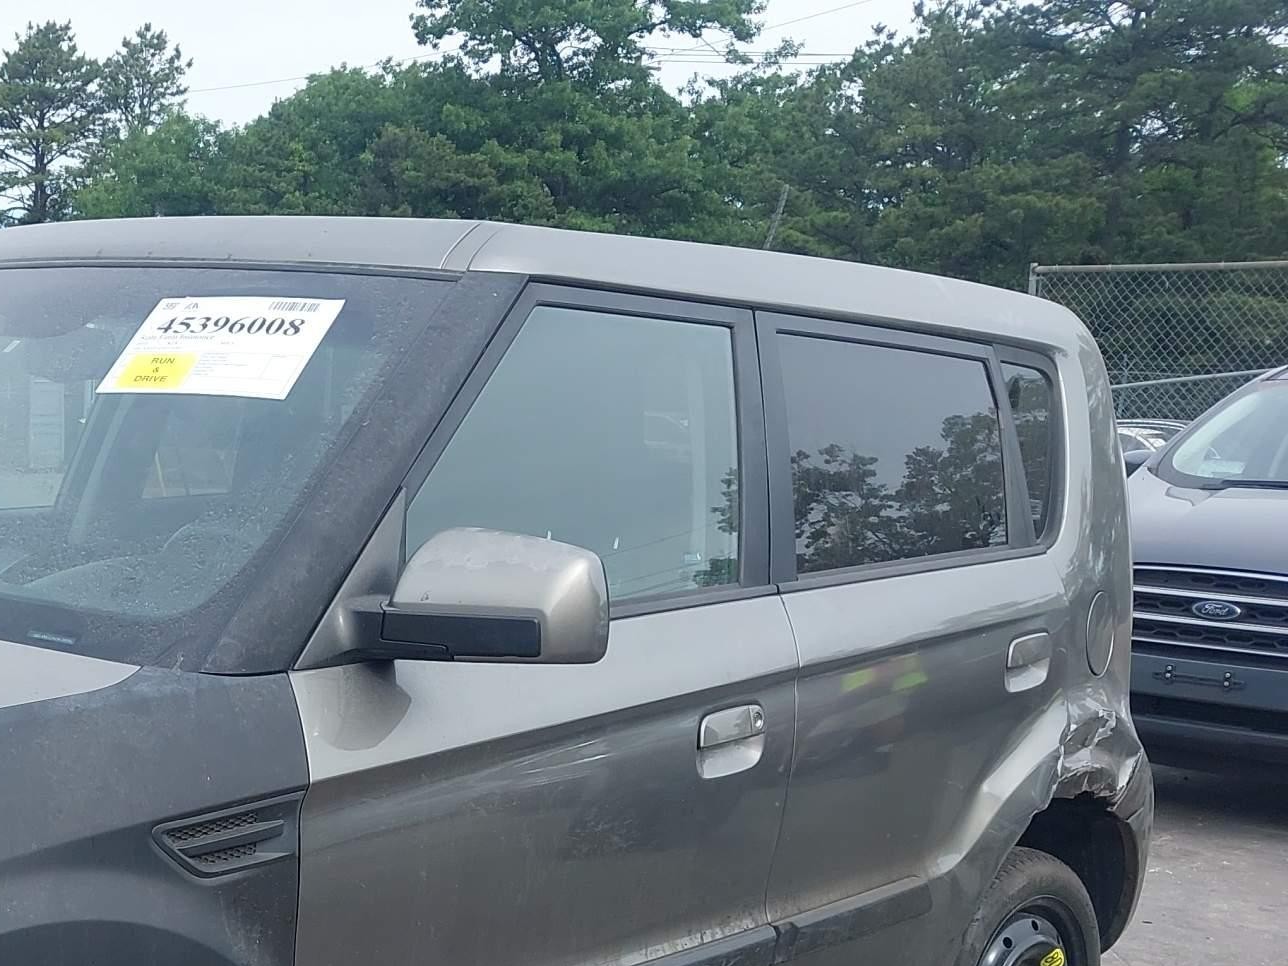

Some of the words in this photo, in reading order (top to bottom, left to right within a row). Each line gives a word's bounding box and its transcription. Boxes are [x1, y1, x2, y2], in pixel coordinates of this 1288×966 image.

[157, 316, 306, 336] 45396008
[151, 357, 175, 365] RUN
[152, 366, 160, 374] &
[133, 375, 168, 383] DRIVE
[1202, 604, 1229, 616] Ford
